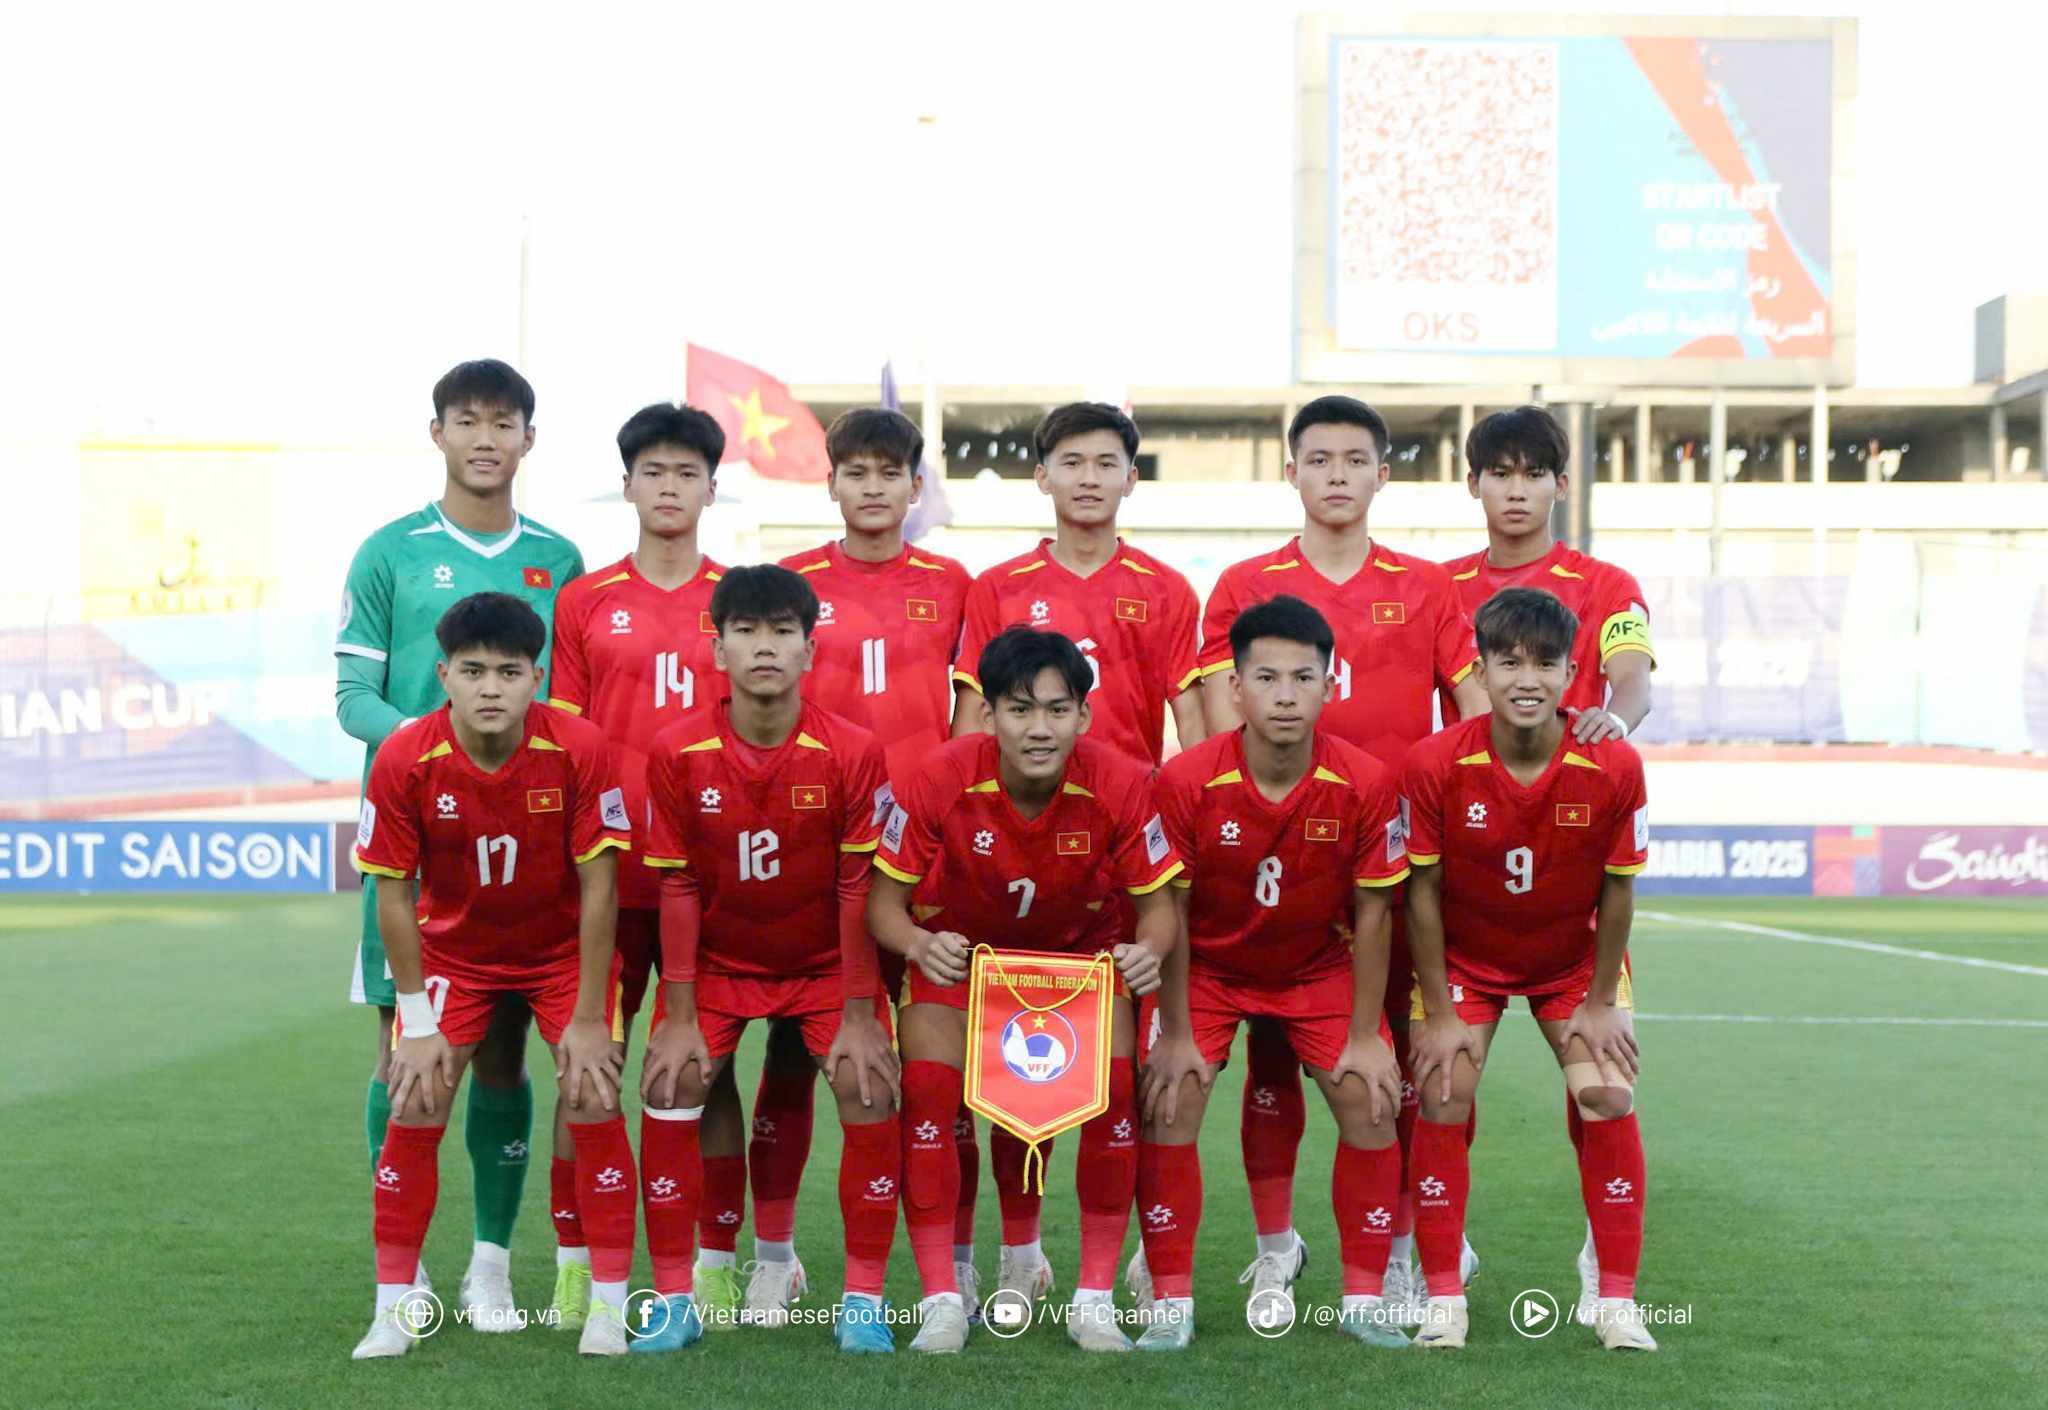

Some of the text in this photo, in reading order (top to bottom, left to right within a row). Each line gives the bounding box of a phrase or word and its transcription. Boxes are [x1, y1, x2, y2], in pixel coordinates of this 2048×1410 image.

[1404, 310, 1480, 341] OKS
[655, 652, 694, 709] 14
[862, 638, 887, 695] 11
[120, 832, 322, 879] SAISON
[477, 833, 518, 887] 17
[738, 829, 780, 881] 12
[1505, 846, 1533, 895] 9
[1729, 839, 1808, 878] 2025
[1008, 877, 1036, 918] 7
[1256, 855, 1283, 907] 8
[1019, 974, 1054, 988] FOOTBALL
[1027, 1063, 1051, 1074] VFF
